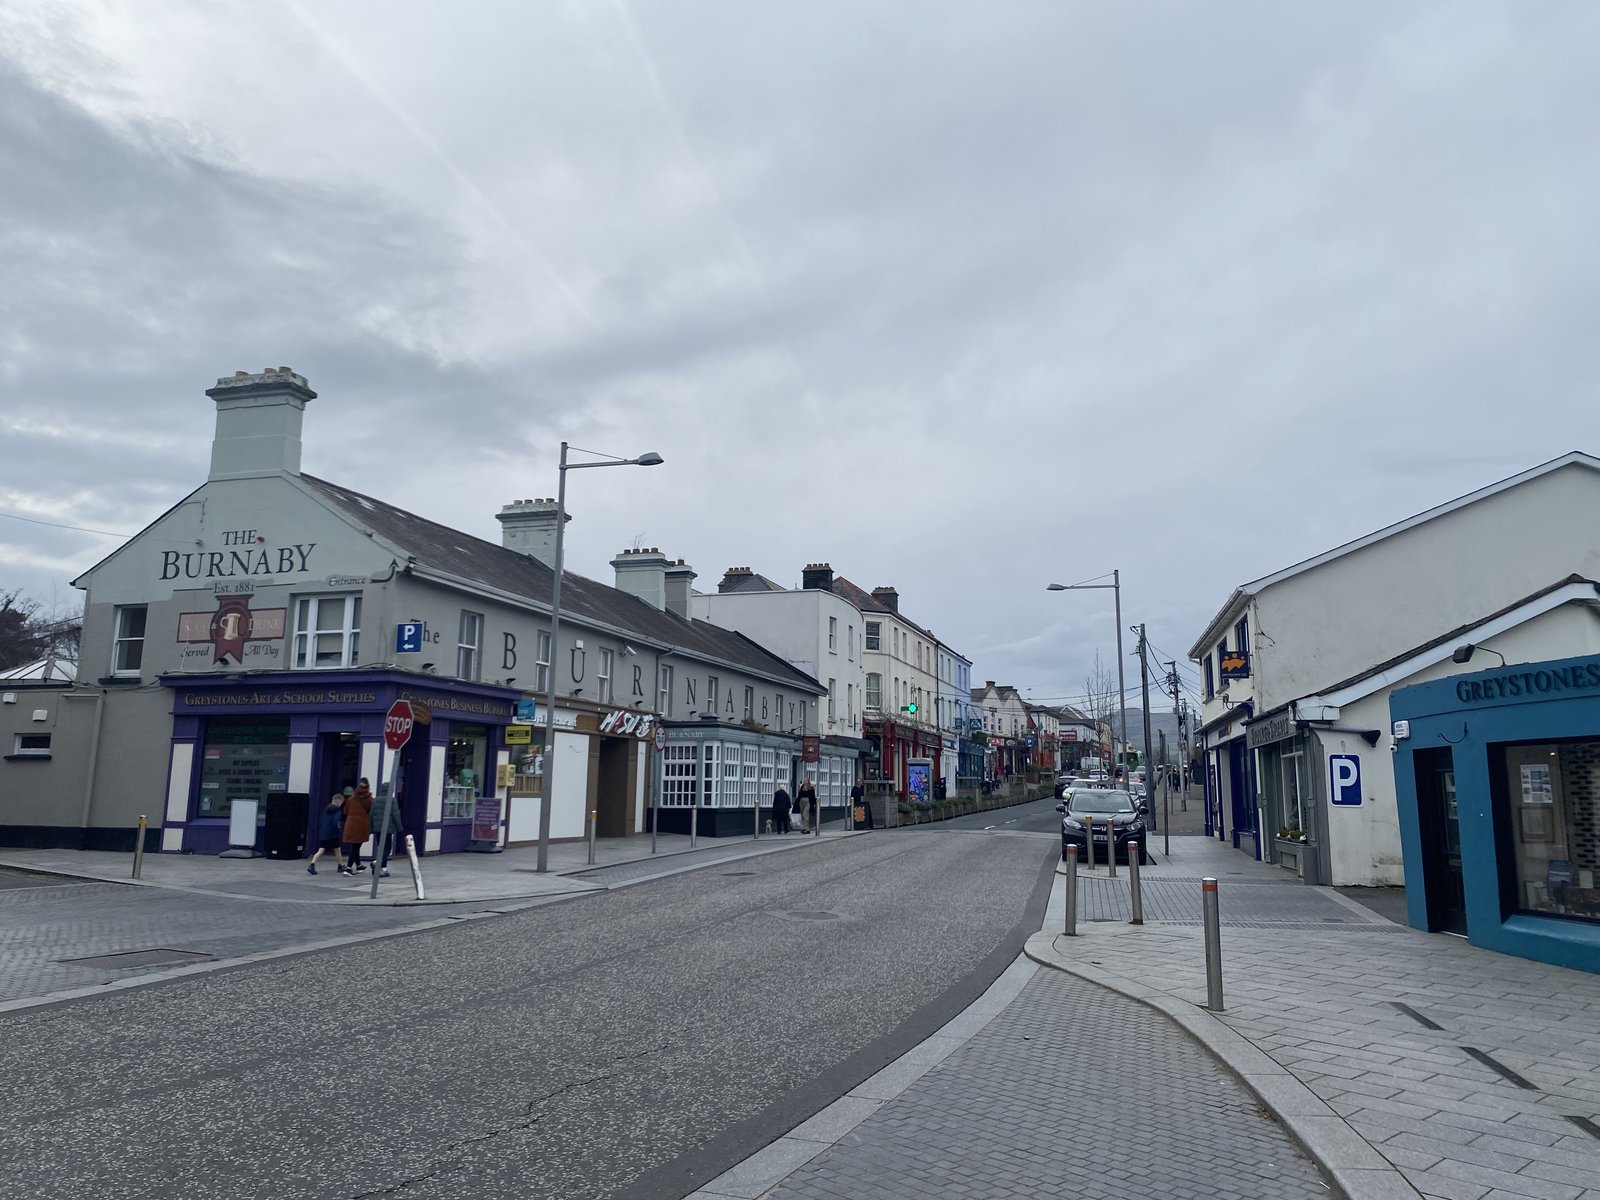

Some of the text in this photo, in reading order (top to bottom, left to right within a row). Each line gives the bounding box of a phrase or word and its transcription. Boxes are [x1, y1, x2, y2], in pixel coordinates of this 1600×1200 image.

[222, 529, 258, 546] THE
[159, 543, 317, 580] BURNABY
[213, 582, 254, 594] Est. 1881
[328, 576, 367, 587] Entrance
[404, 625, 415, 641] P
[181, 644, 279, 658] Served All Day
[1456, 663, 1600, 703] GREYSTONES
[185, 690, 376, 705] GREYSTONES ART & SCHOOL SUPPLIES
[450, 698, 483, 713] BUSINESS
[385, 716, 411, 734] STOP
[1332, 758, 1358, 801] P
